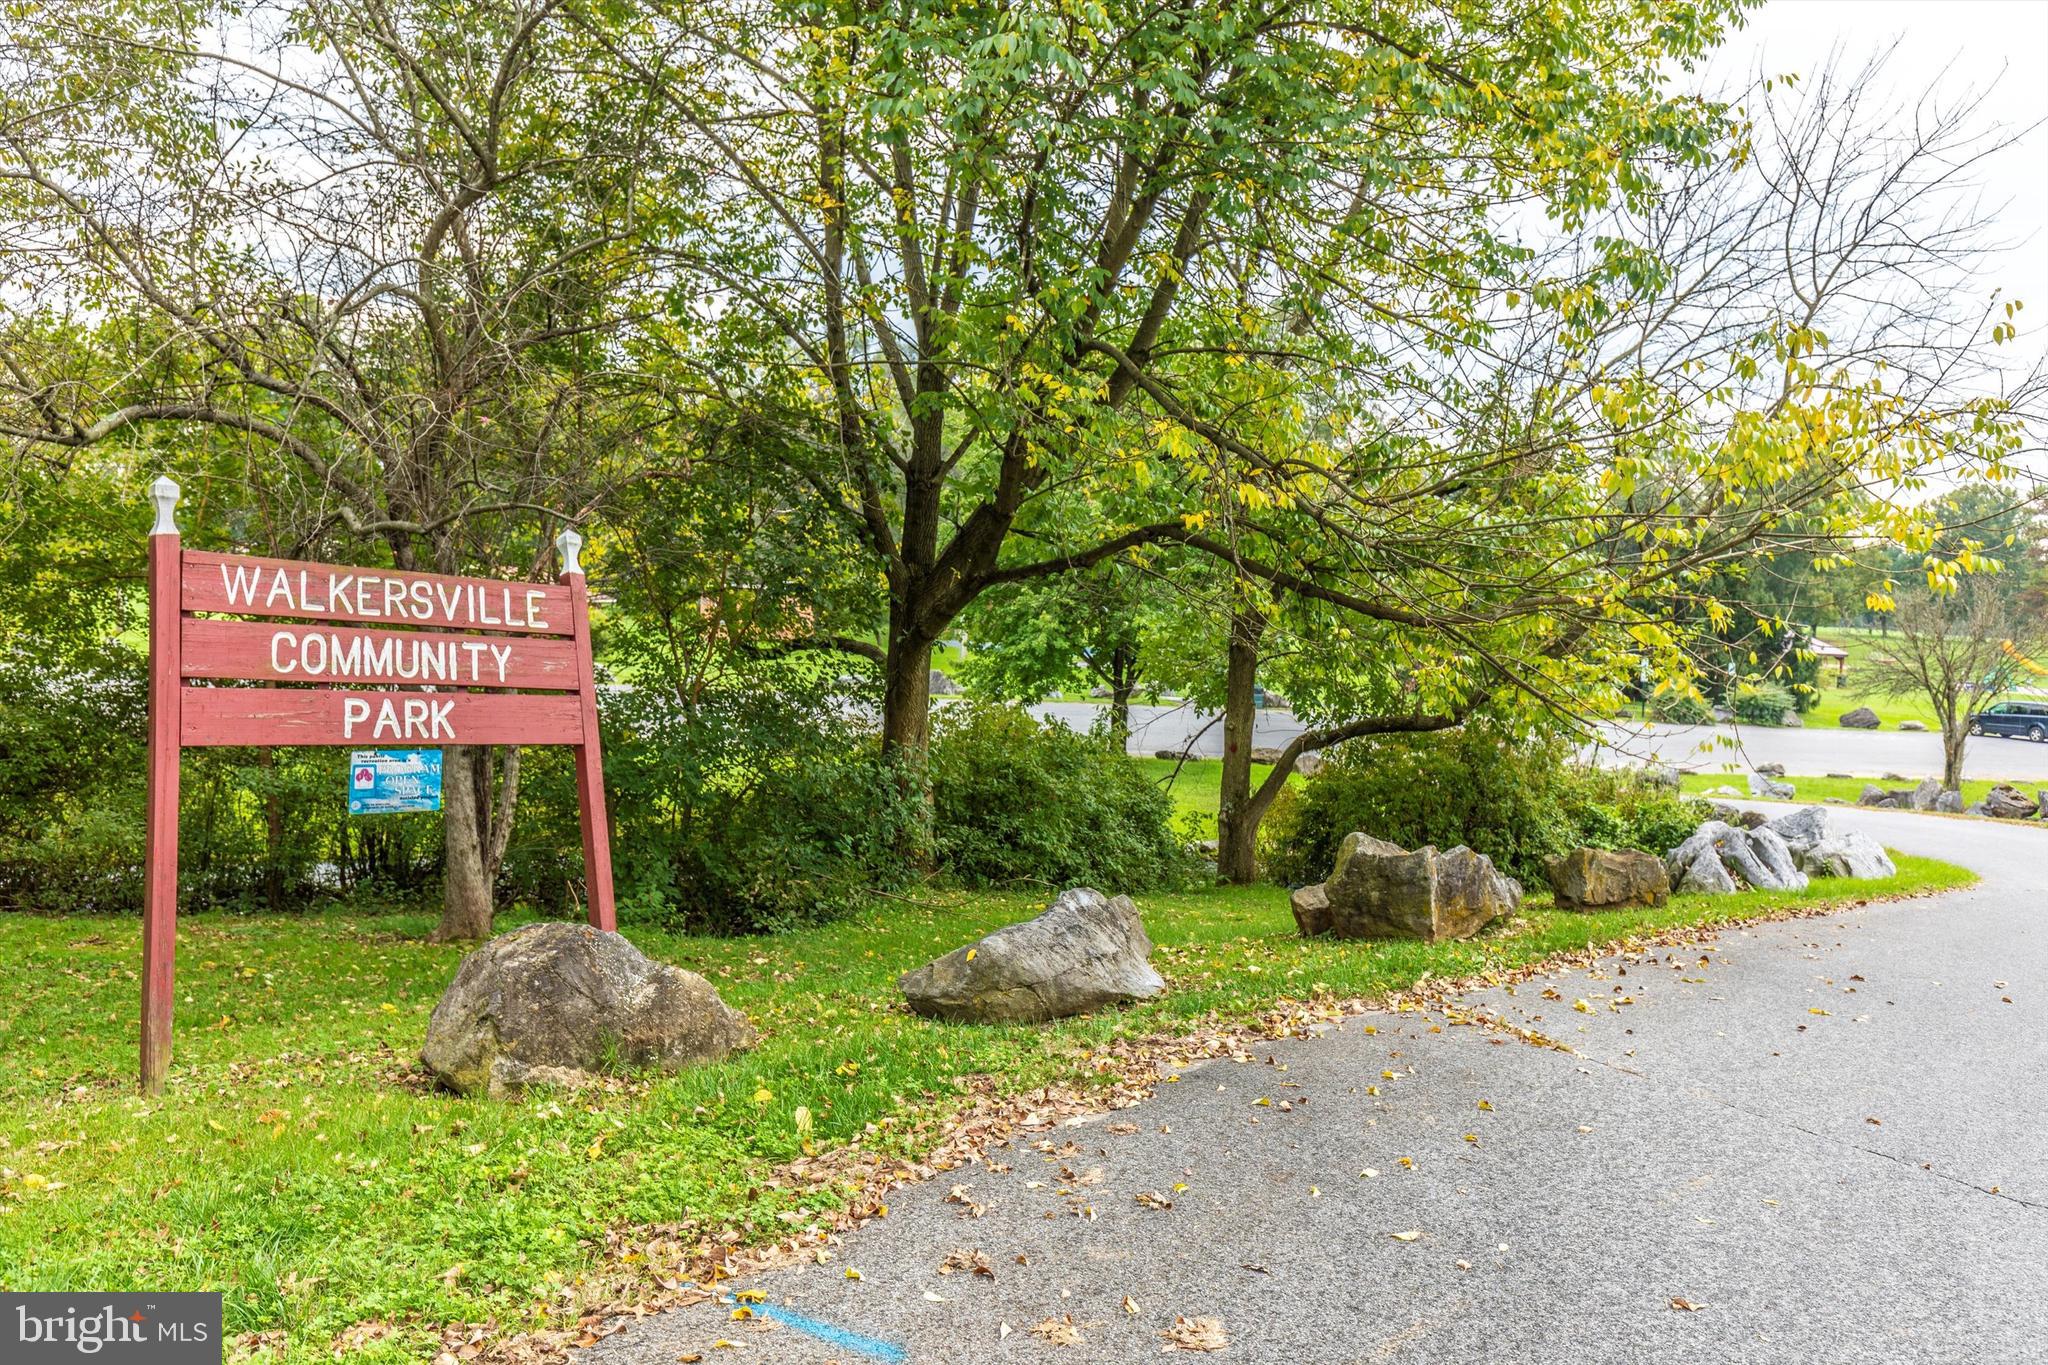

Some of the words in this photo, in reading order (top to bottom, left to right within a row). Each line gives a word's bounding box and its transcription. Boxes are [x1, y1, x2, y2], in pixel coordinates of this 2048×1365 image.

[220, 563, 549, 629] WALKERSVILLE
[271, 631, 513, 683] COMMUNITY
[343, 697, 456, 740] PARK
[385, 775, 419, 785] OPEN
[394, 784, 434, 796] SPACE
